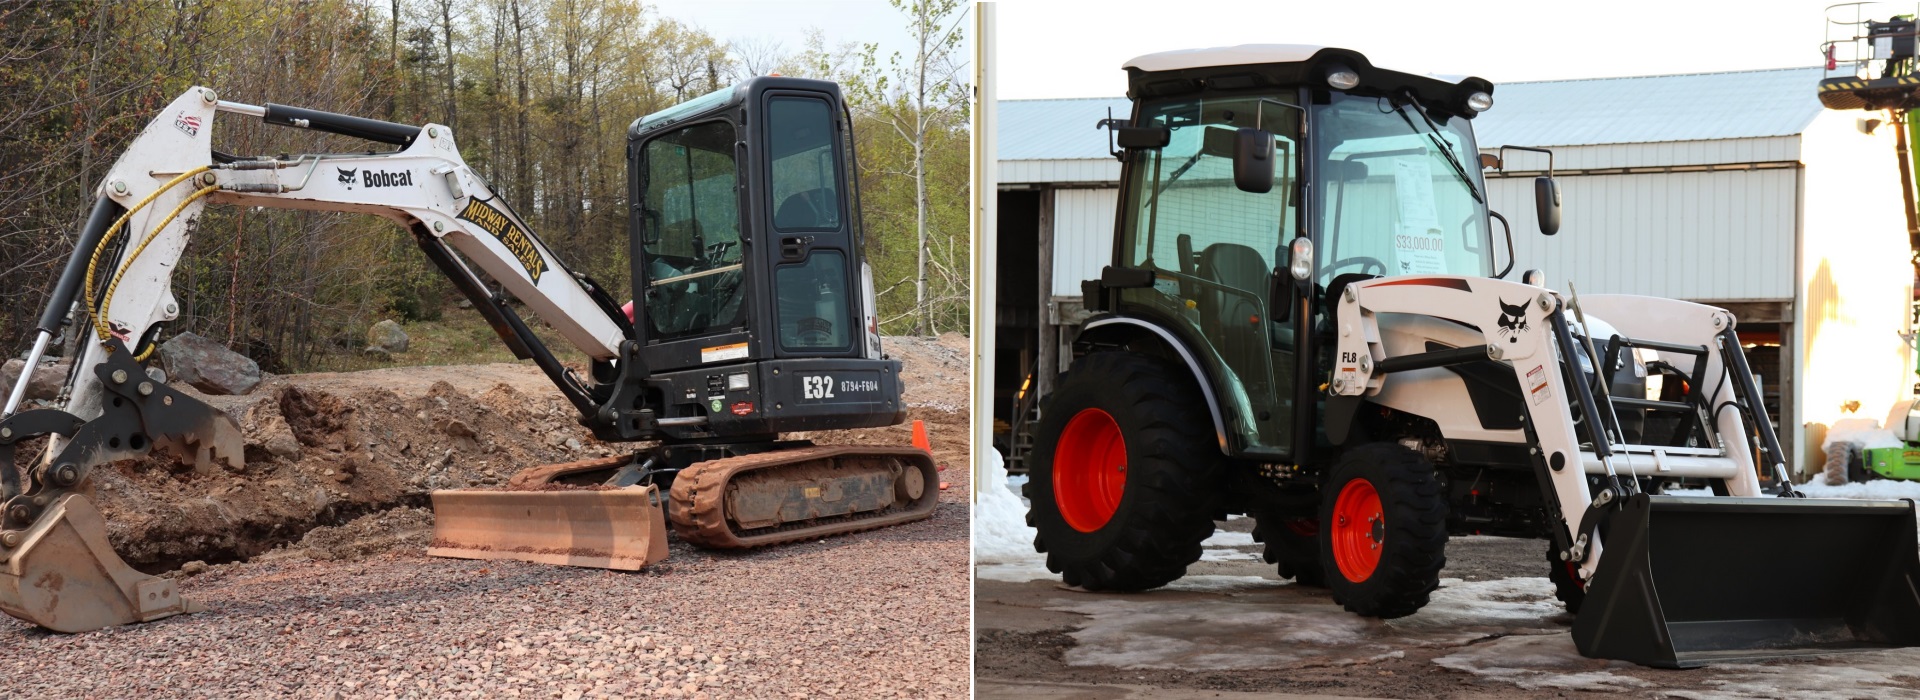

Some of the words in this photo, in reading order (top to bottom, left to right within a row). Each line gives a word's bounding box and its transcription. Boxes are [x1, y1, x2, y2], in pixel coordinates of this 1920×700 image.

[175, 119, 197, 137] USA
[362, 169, 413, 188] Bobcat
[463, 199, 509, 232] MIDWAY
[506, 225, 543, 280] RENTALS
[475, 217, 500, 236] AND
[502, 236, 532, 271] SALES
[1342, 351, 1357, 363] FL8
[803, 375, 835, 399] E32
[841, 380, 879, 392] 8794-F604
